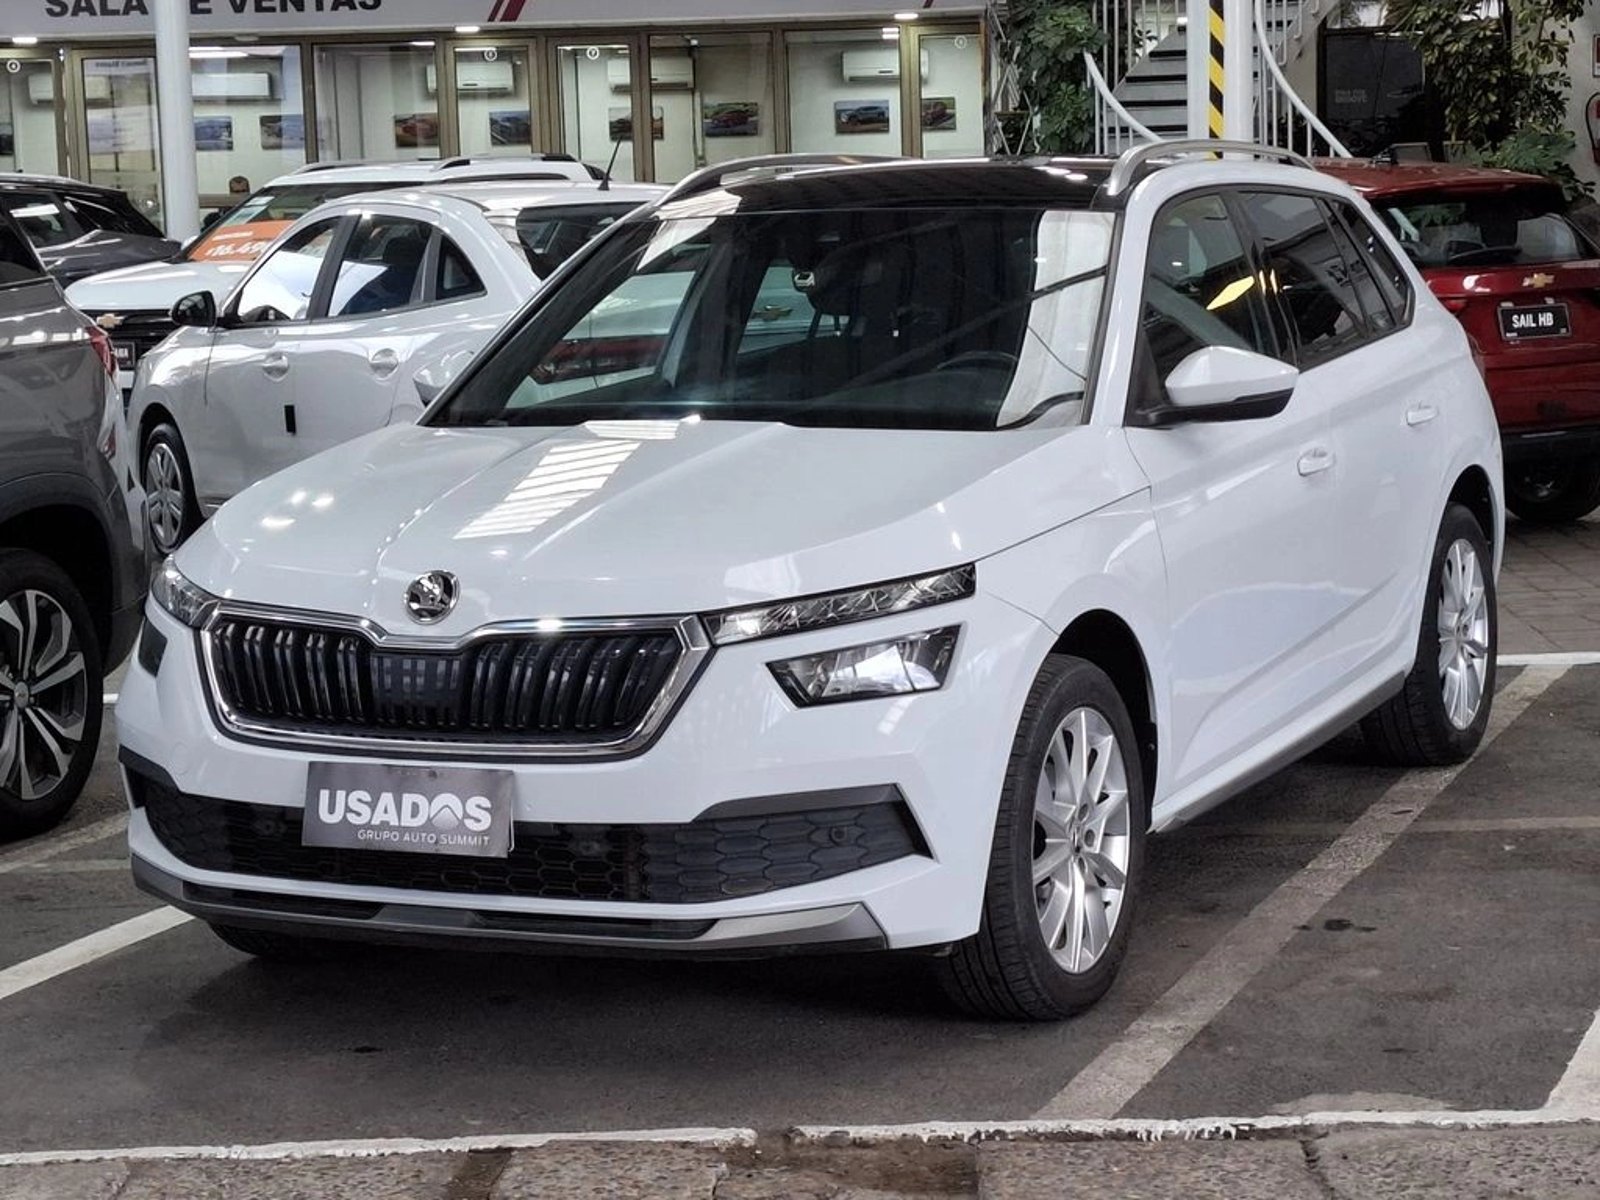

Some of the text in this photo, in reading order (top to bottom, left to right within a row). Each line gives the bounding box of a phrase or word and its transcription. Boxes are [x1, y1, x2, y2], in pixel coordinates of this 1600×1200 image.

[45, 0, 149, 17] SALA
[190, 0, 213, 15] E
[1512, 312, 1554, 328] SAIL HB
[318, 789, 492, 831] USADOS
[357, 829, 491, 846] GRUPO AUTO SUMMIT
